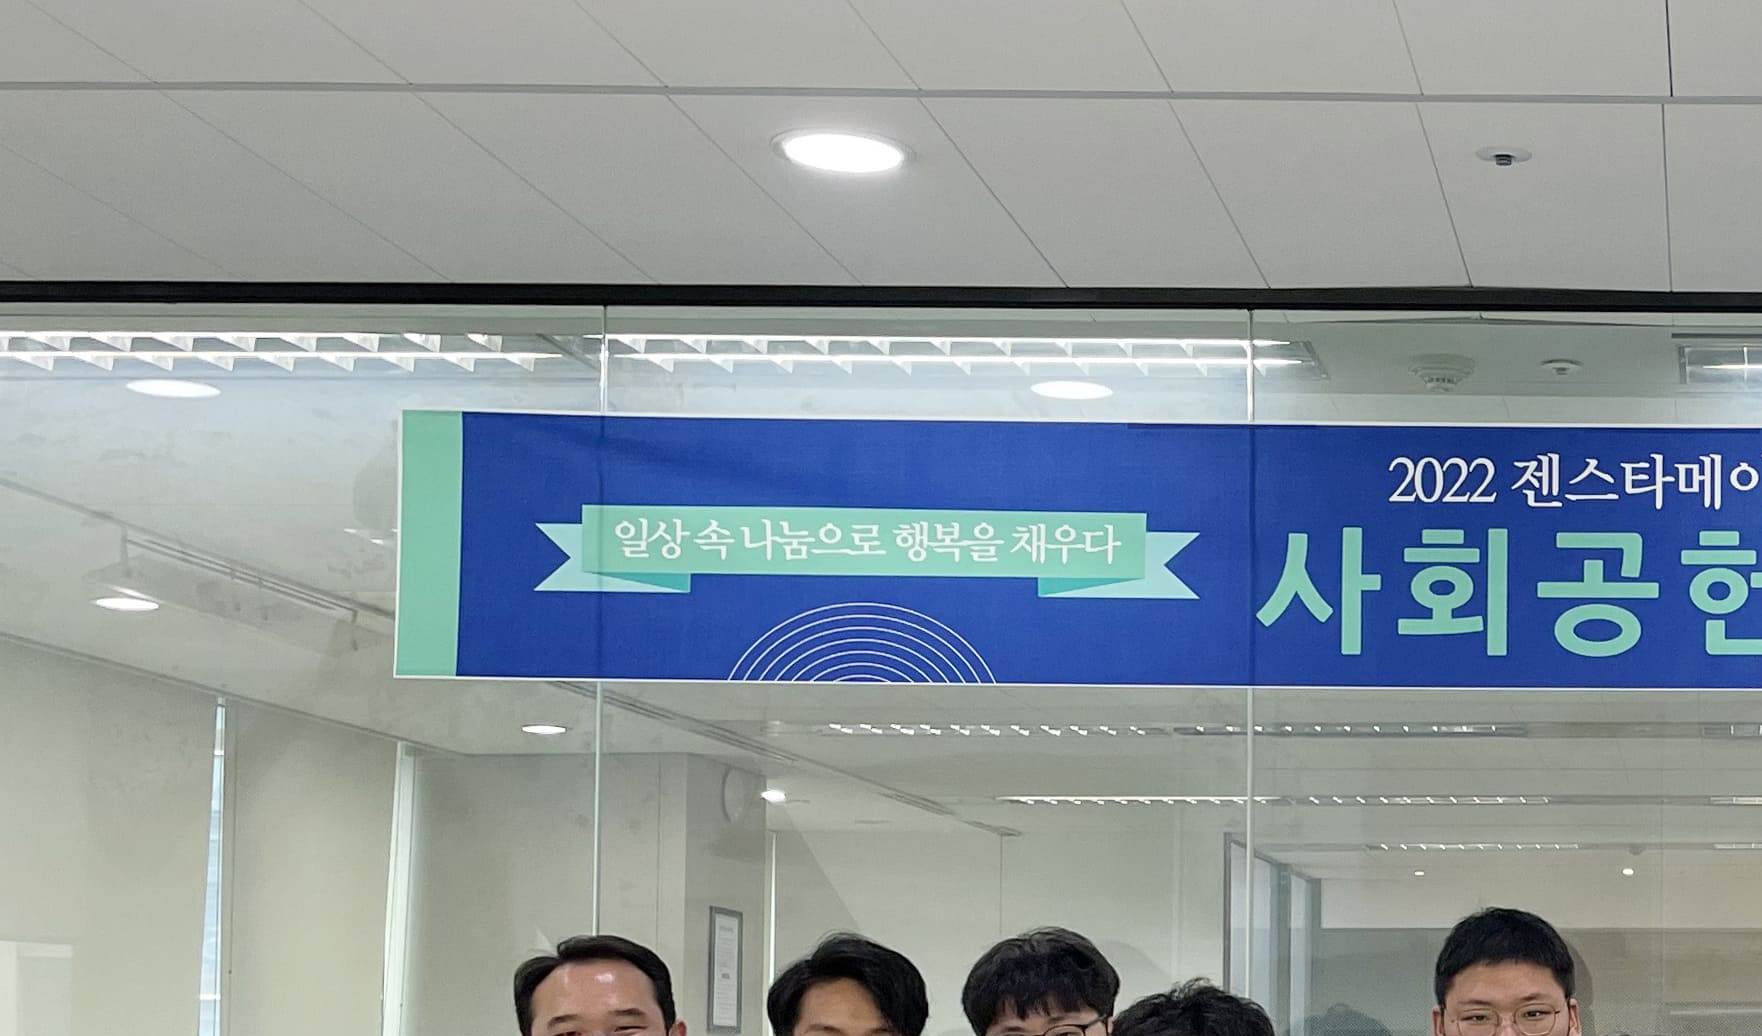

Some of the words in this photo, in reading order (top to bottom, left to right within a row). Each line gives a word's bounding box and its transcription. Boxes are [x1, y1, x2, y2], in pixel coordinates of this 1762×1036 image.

[1387, 456, 1497, 503] 2022
[613, 517, 691, 560] 일상
[693, 518, 736, 561] 속
[739, 518, 888, 562] 나눔으로
[891, 520, 1006, 563] 행복을
[1009, 522, 1123, 565] 채우다
